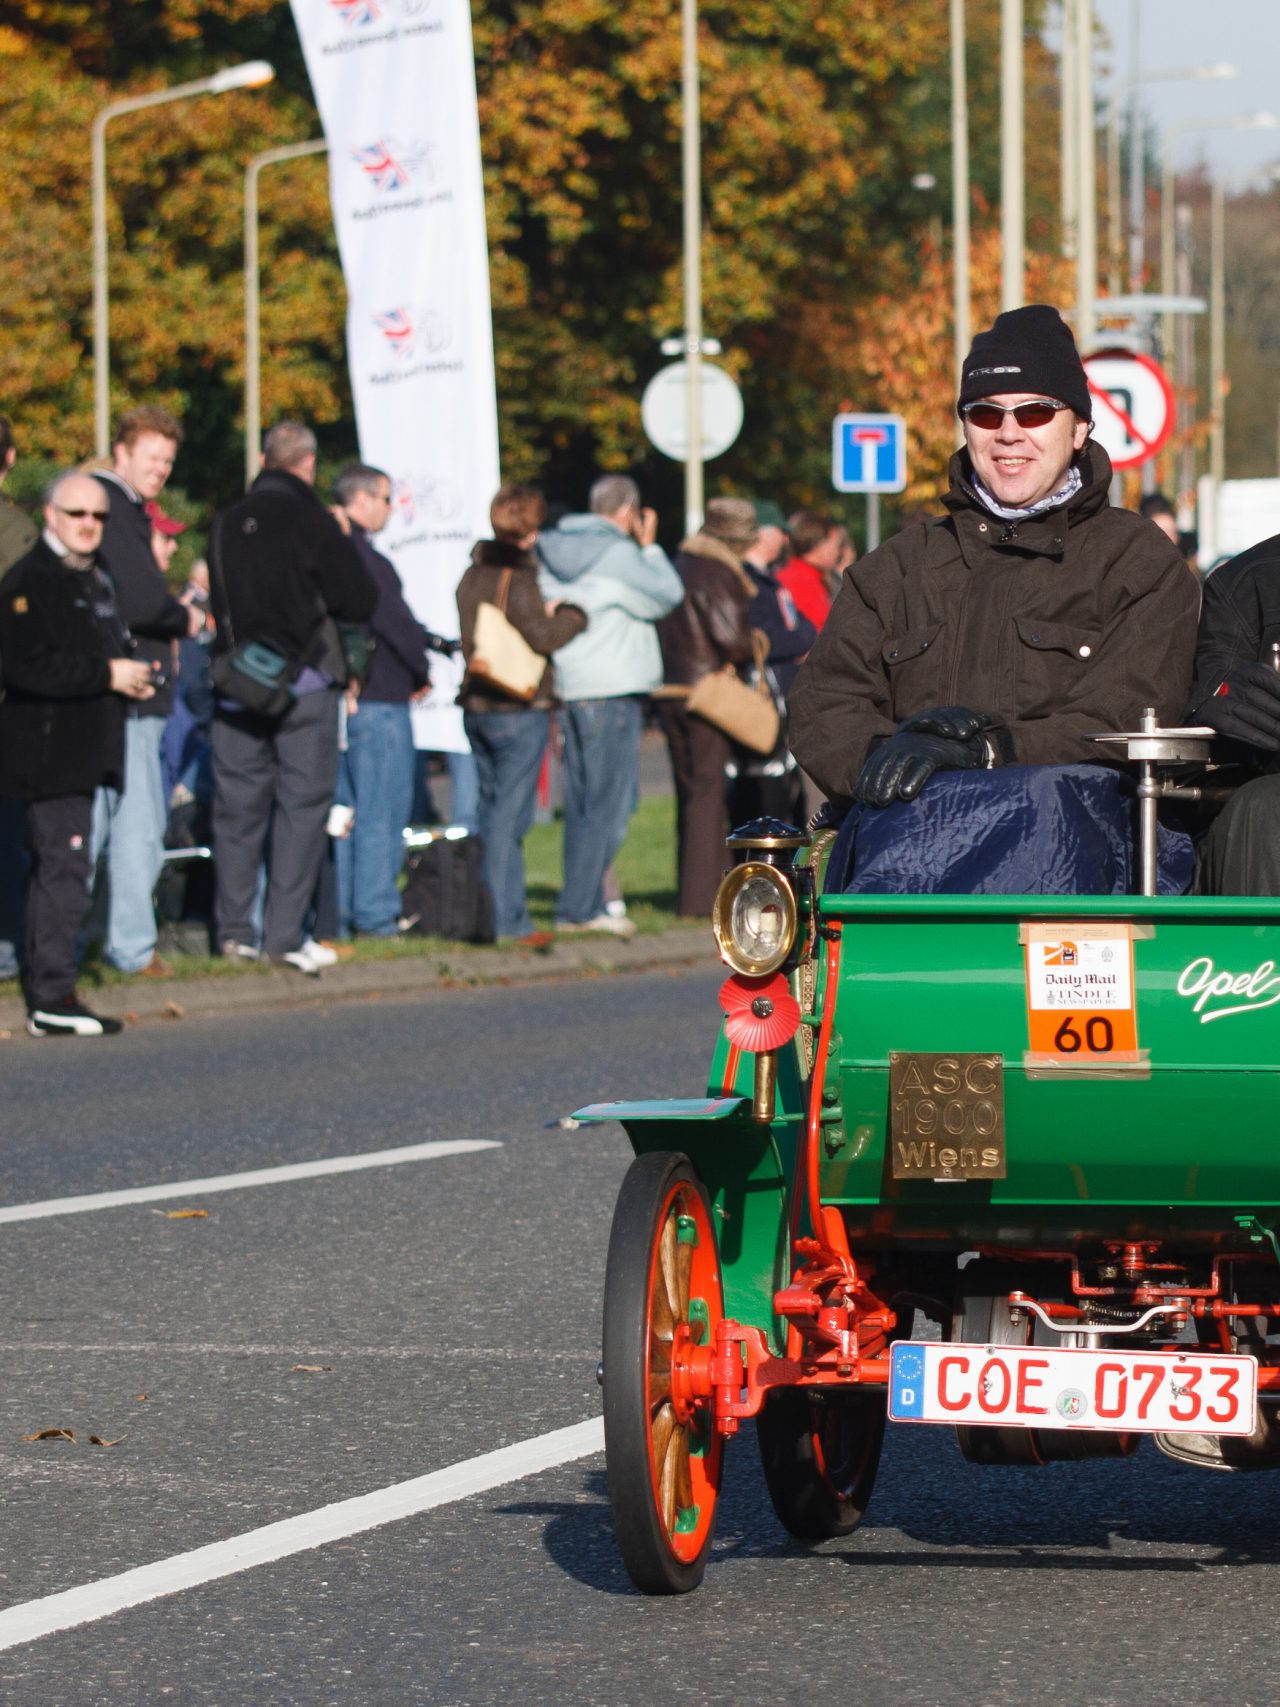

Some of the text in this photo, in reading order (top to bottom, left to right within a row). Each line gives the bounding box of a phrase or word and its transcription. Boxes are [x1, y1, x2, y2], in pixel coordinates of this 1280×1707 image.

[1045, 973, 1117, 987] Daily Mail
[1057, 990, 1115, 998] TINDLE
[1054, 1016, 1115, 1056] 60
[897, 1059, 998, 1095] ASC
[896, 1099, 998, 1136] 1900
[898, 1142, 1001, 1169] Wiens
[902, 1388, 915, 1406] D
[937, 1356, 1241, 1424] COE 0733
